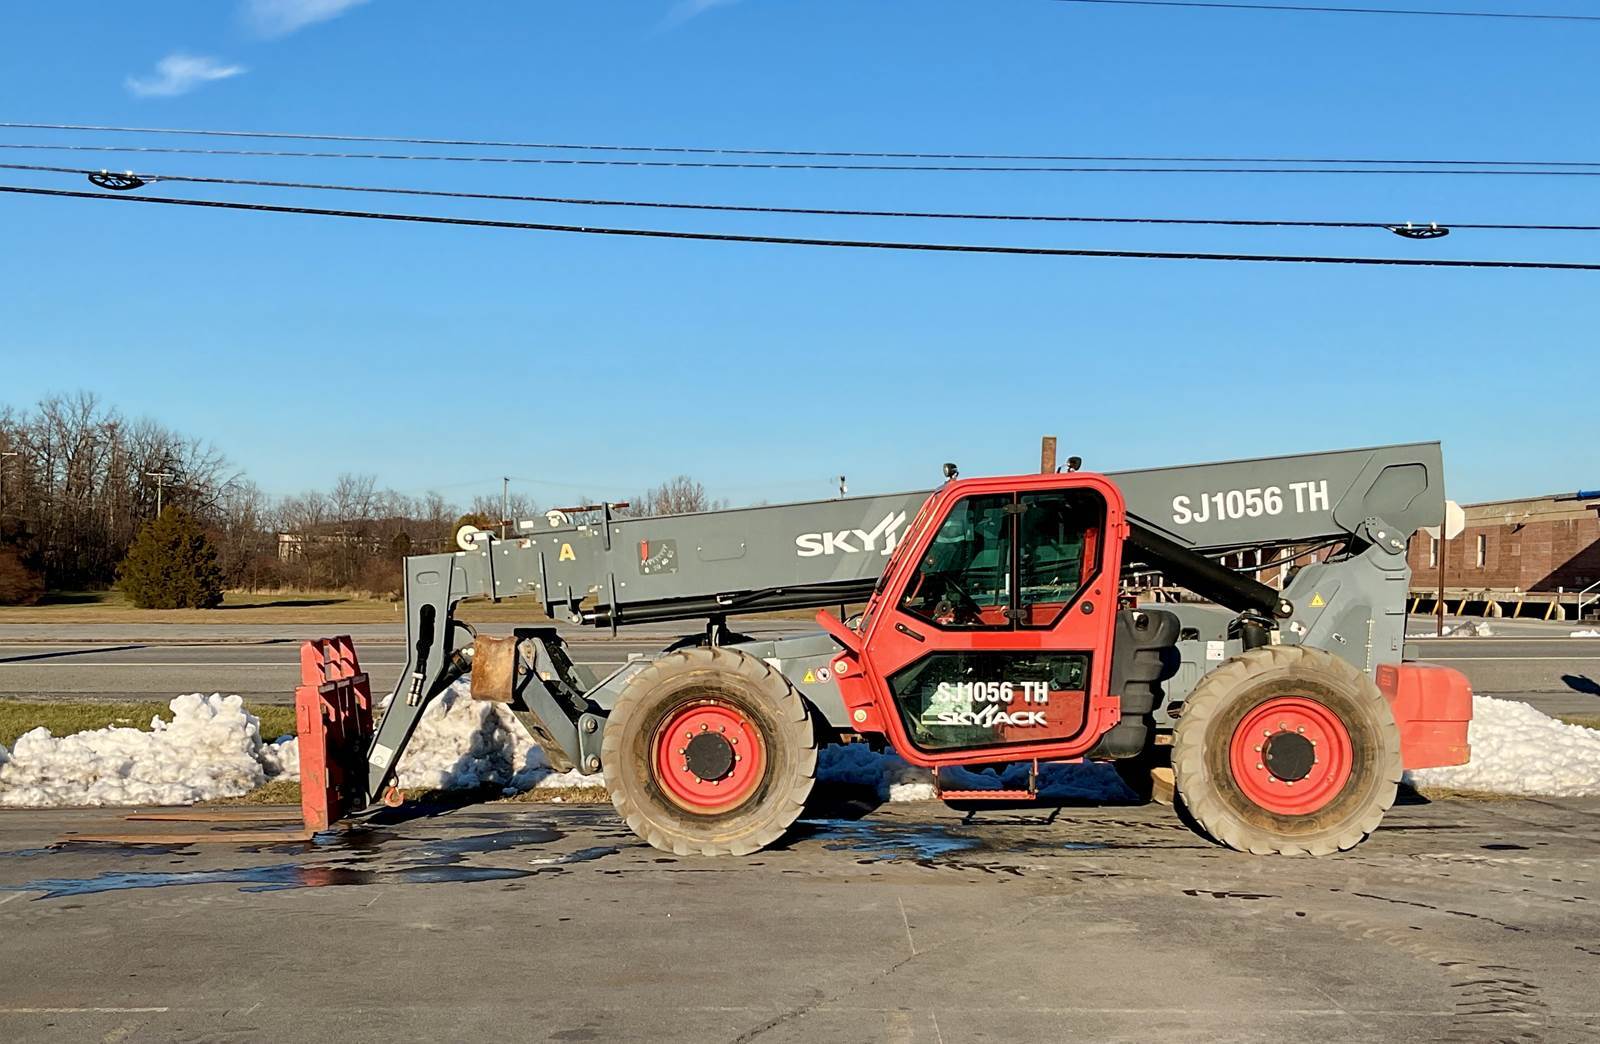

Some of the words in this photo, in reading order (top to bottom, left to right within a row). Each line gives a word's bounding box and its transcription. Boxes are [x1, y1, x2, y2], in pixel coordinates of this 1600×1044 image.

[1172, 486, 1283, 525] SJ1056
[1288, 480, 1329, 513] TH
[559, 543, 576, 561] A
[938, 681, 1013, 702] SJ1056
[1021, 681, 1048, 702] TH
[937, 703, 1048, 728] SKYJACK
